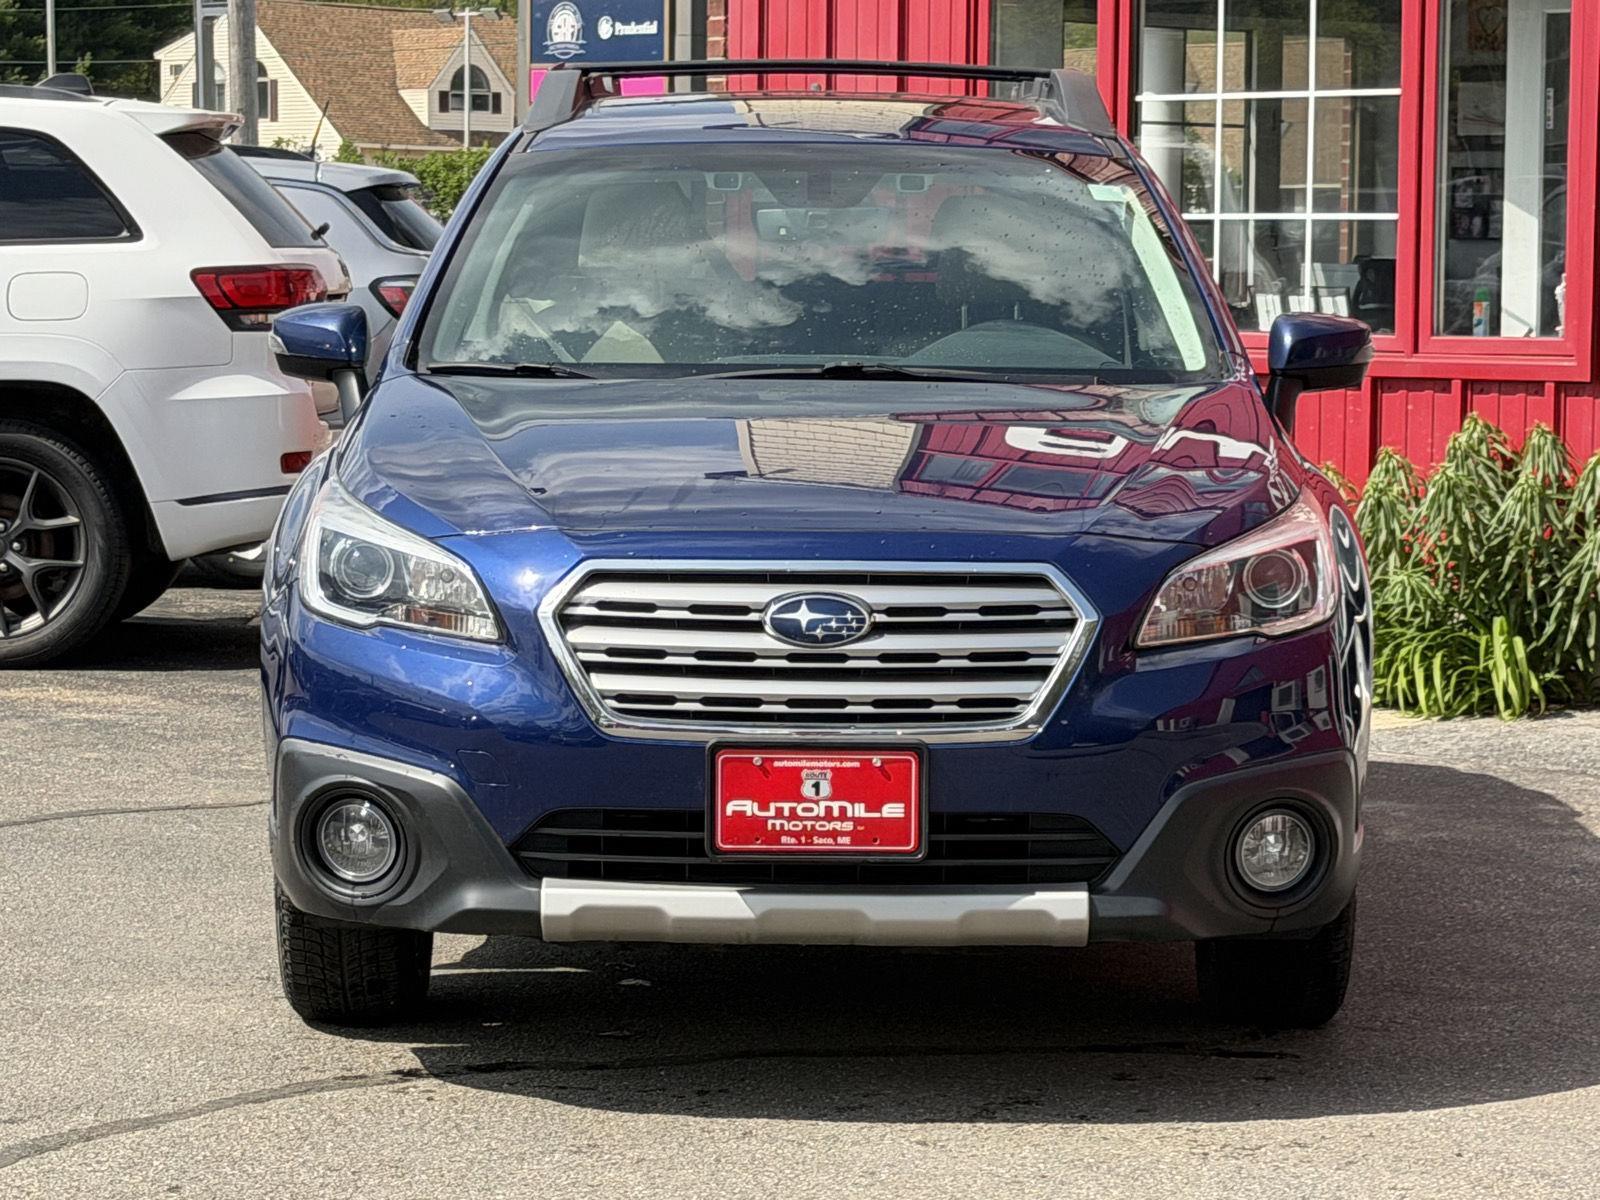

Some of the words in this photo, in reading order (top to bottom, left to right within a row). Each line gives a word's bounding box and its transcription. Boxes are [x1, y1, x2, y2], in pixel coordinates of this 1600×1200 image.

[773, 759, 860, 769] automilemotors.com
[811, 781, 821, 797] 1
[767, 819, 854, 831] MOTORS
[837, 836, 851, 844] ME
